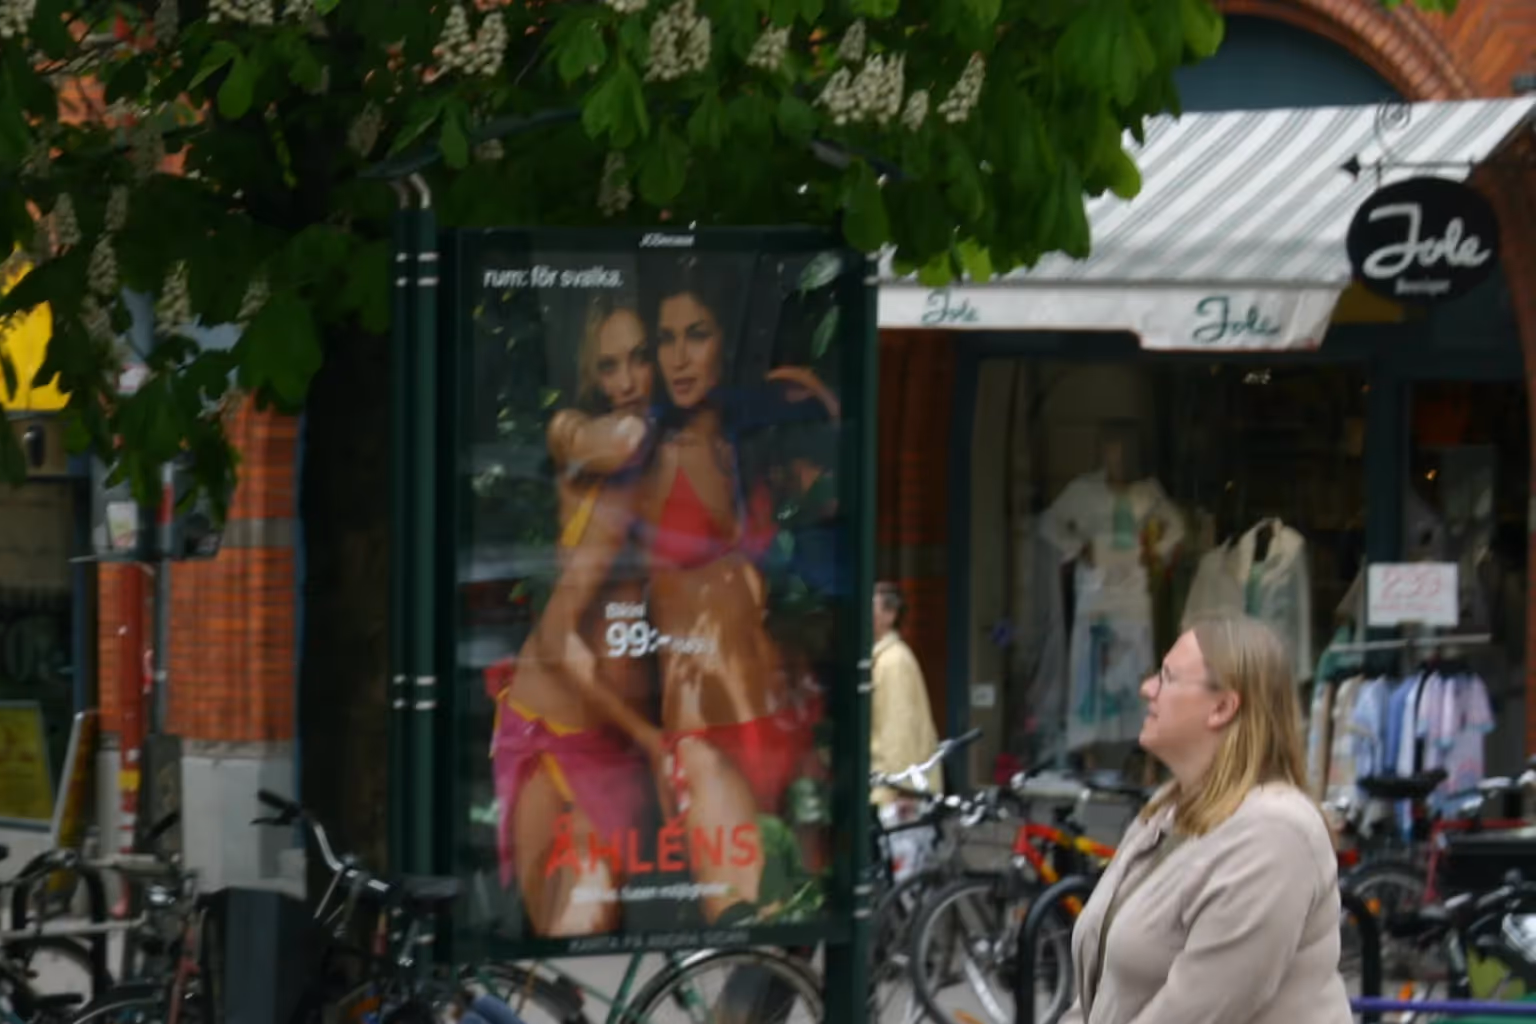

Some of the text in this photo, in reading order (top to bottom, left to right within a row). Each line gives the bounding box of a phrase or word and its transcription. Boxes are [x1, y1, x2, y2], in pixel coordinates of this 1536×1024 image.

[1361, 201, 1492, 279] Jole
[530, 265, 556, 288] för
[1191, 297, 1282, 344] Jole
[545, 809, 759, 879] ÅHLÉNS
